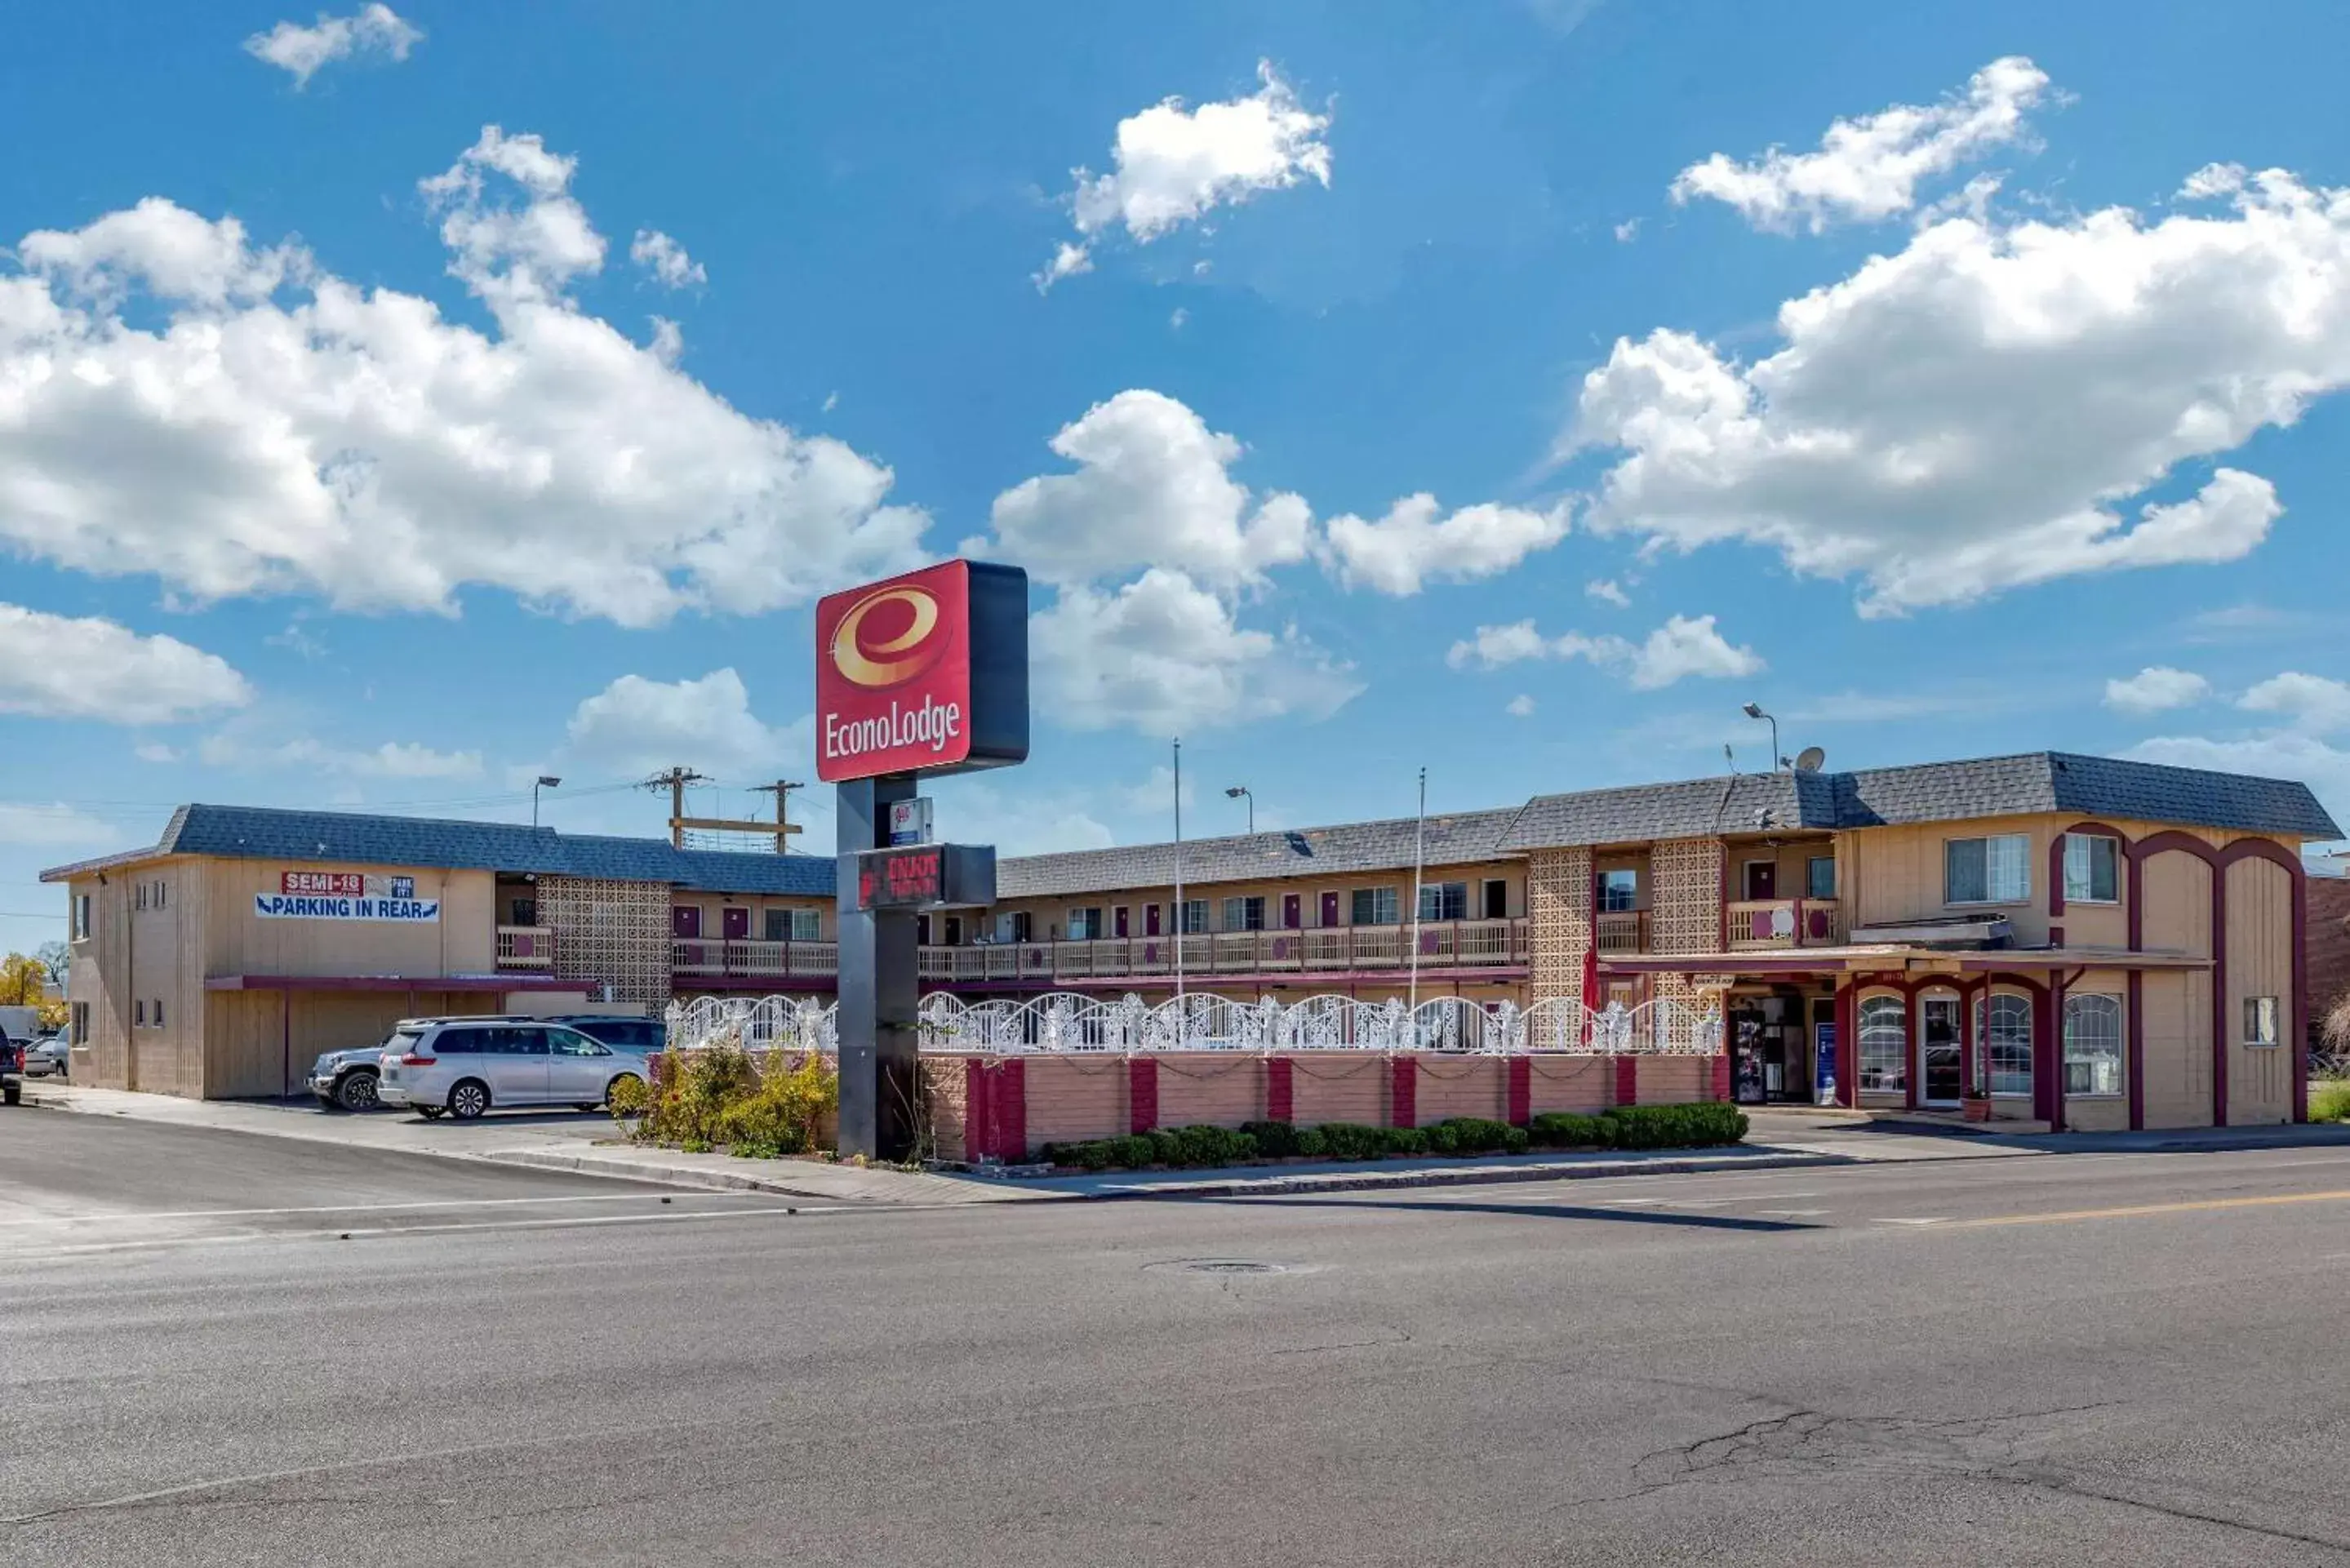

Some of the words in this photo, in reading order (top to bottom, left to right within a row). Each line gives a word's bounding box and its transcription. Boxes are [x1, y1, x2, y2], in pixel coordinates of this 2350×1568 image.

[826, 694, 959, 758] EconoLodge
[286, 873, 359, 891] SEMI-18
[272, 897, 350, 917] PARKING
[356, 899, 373, 917] IN
[379, 900, 423, 918] REAR
